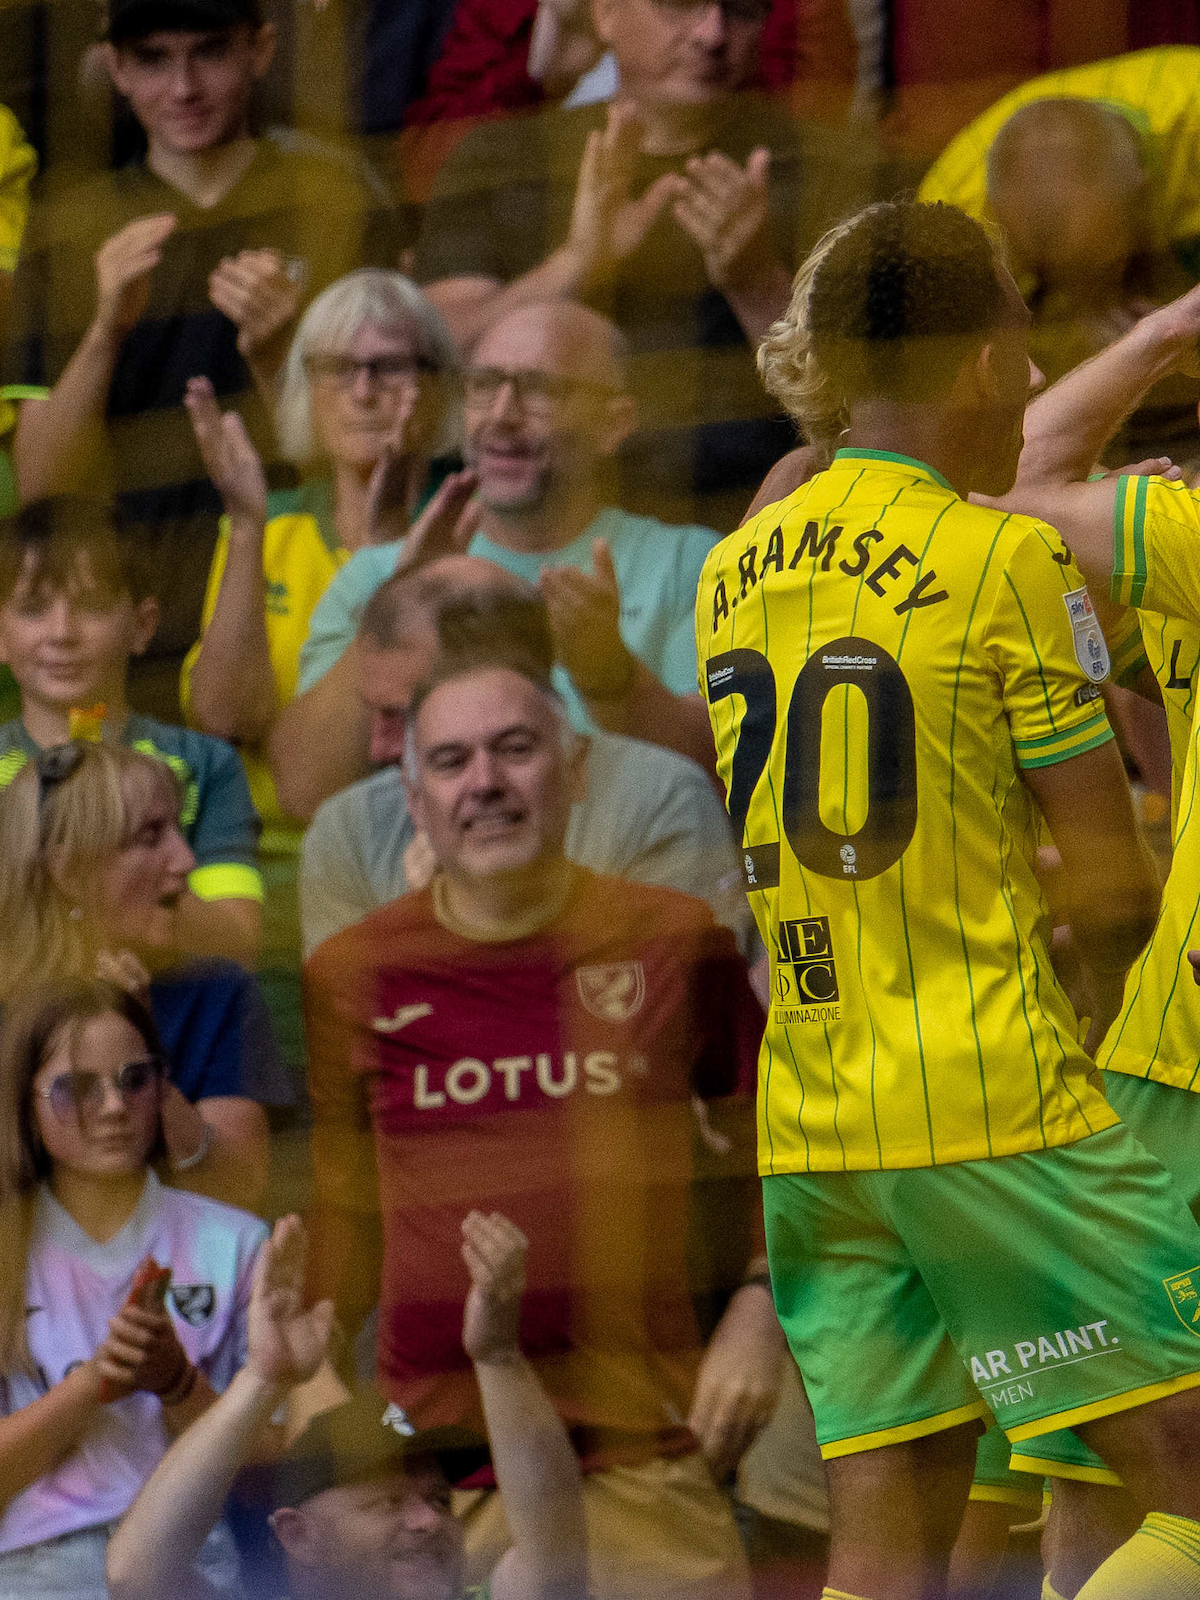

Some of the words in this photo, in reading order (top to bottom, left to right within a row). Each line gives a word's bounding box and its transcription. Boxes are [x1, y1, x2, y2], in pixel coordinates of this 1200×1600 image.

[713, 521, 950, 635] A.RAMSEY
[706, 636, 918, 882] 20
[843, 864, 858, 874] EFL
[413, 1051, 622, 1110] LOTUS
[970, 1350, 1012, 1384] AR
[1014, 1320, 1120, 1369] PAINT.
[991, 1381, 1034, 1409] MEN
